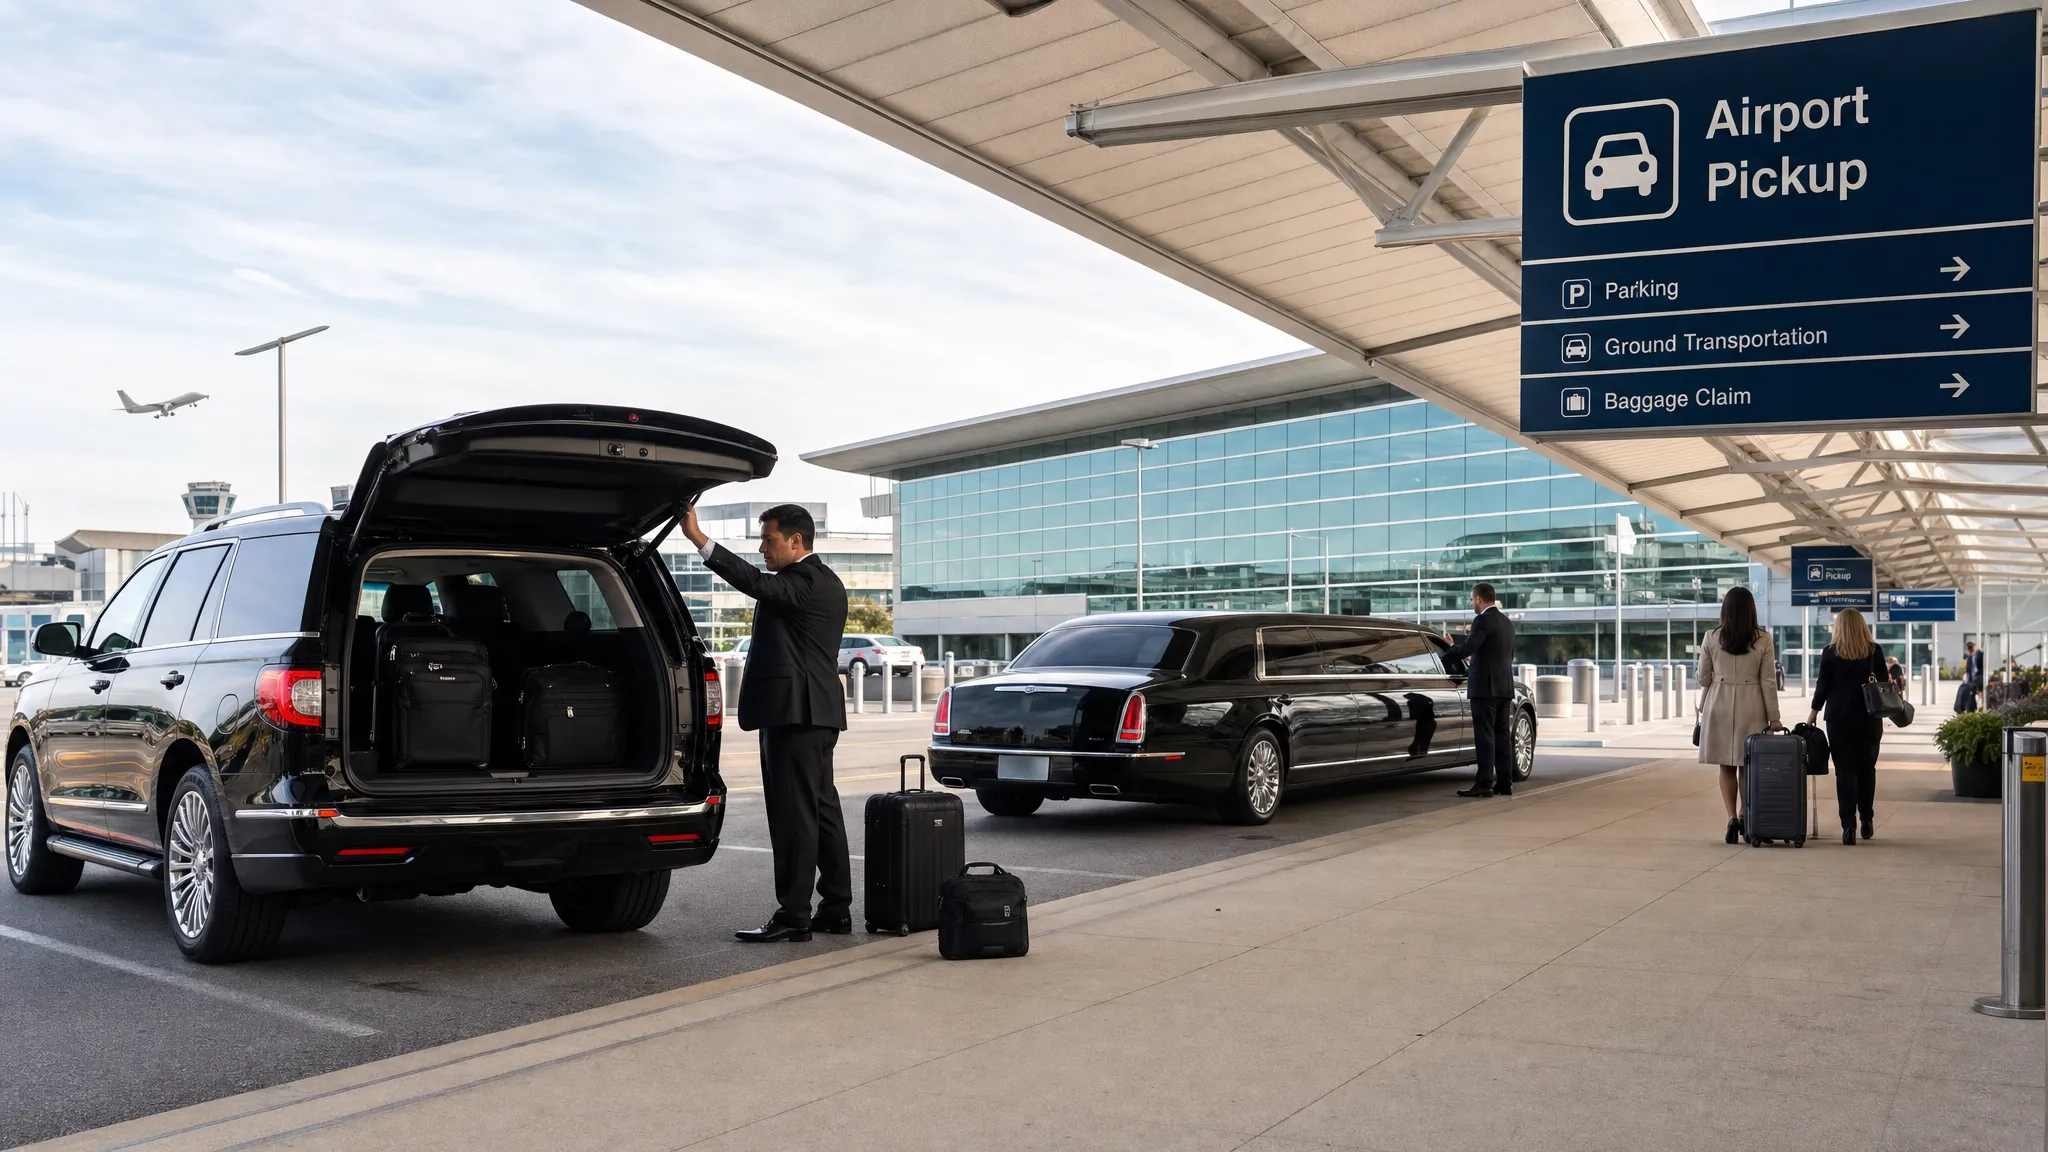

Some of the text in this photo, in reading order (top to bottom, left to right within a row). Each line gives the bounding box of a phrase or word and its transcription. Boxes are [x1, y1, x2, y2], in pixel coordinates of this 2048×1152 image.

[1705, 86, 1869, 143] Airport
[1708, 156, 1868, 201] Pickup
[1569, 280, 1679, 304] P Parking
[1605, 326, 1828, 356] Ground Transportation
[1605, 387, 1751, 414] Baggage Claim
[1825, 571, 1852, 582] Pickup
